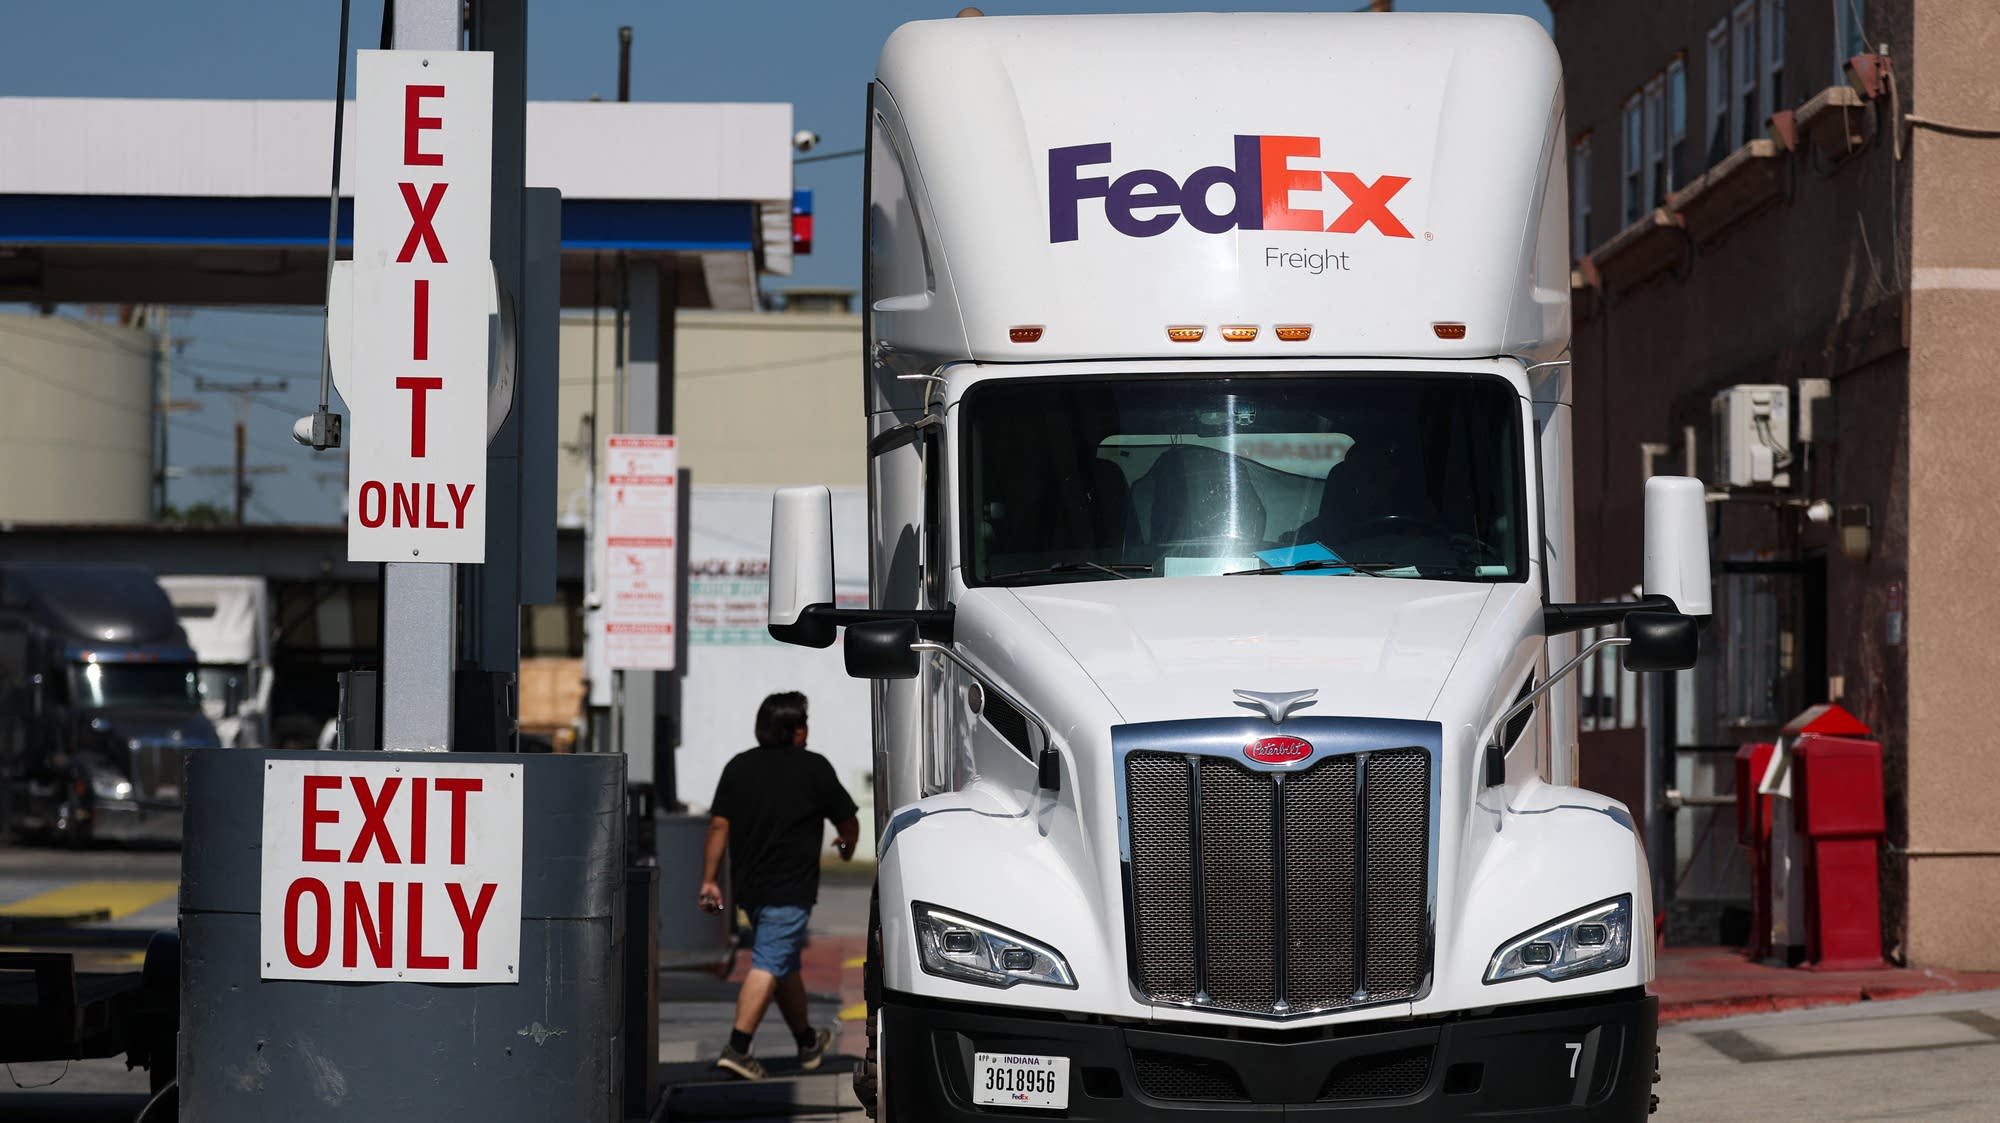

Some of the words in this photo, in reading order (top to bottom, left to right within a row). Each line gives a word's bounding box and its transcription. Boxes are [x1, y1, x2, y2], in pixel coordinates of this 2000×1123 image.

[1048, 134, 1415, 243] FedEx
[396, 84, 449, 457] EXIT
[1265, 247, 1350, 275] Freight
[358, 480, 476, 529] ONLY
[1252, 741, 1305, 758] Peterbilt
[301, 775, 483, 865] EXIT
[284, 876, 498, 970] ONLY
[985, 1067, 1056, 1093] 3618956
[1004, 1056, 1040, 1065] INDIANA
[1565, 1043, 1582, 1078] 7
